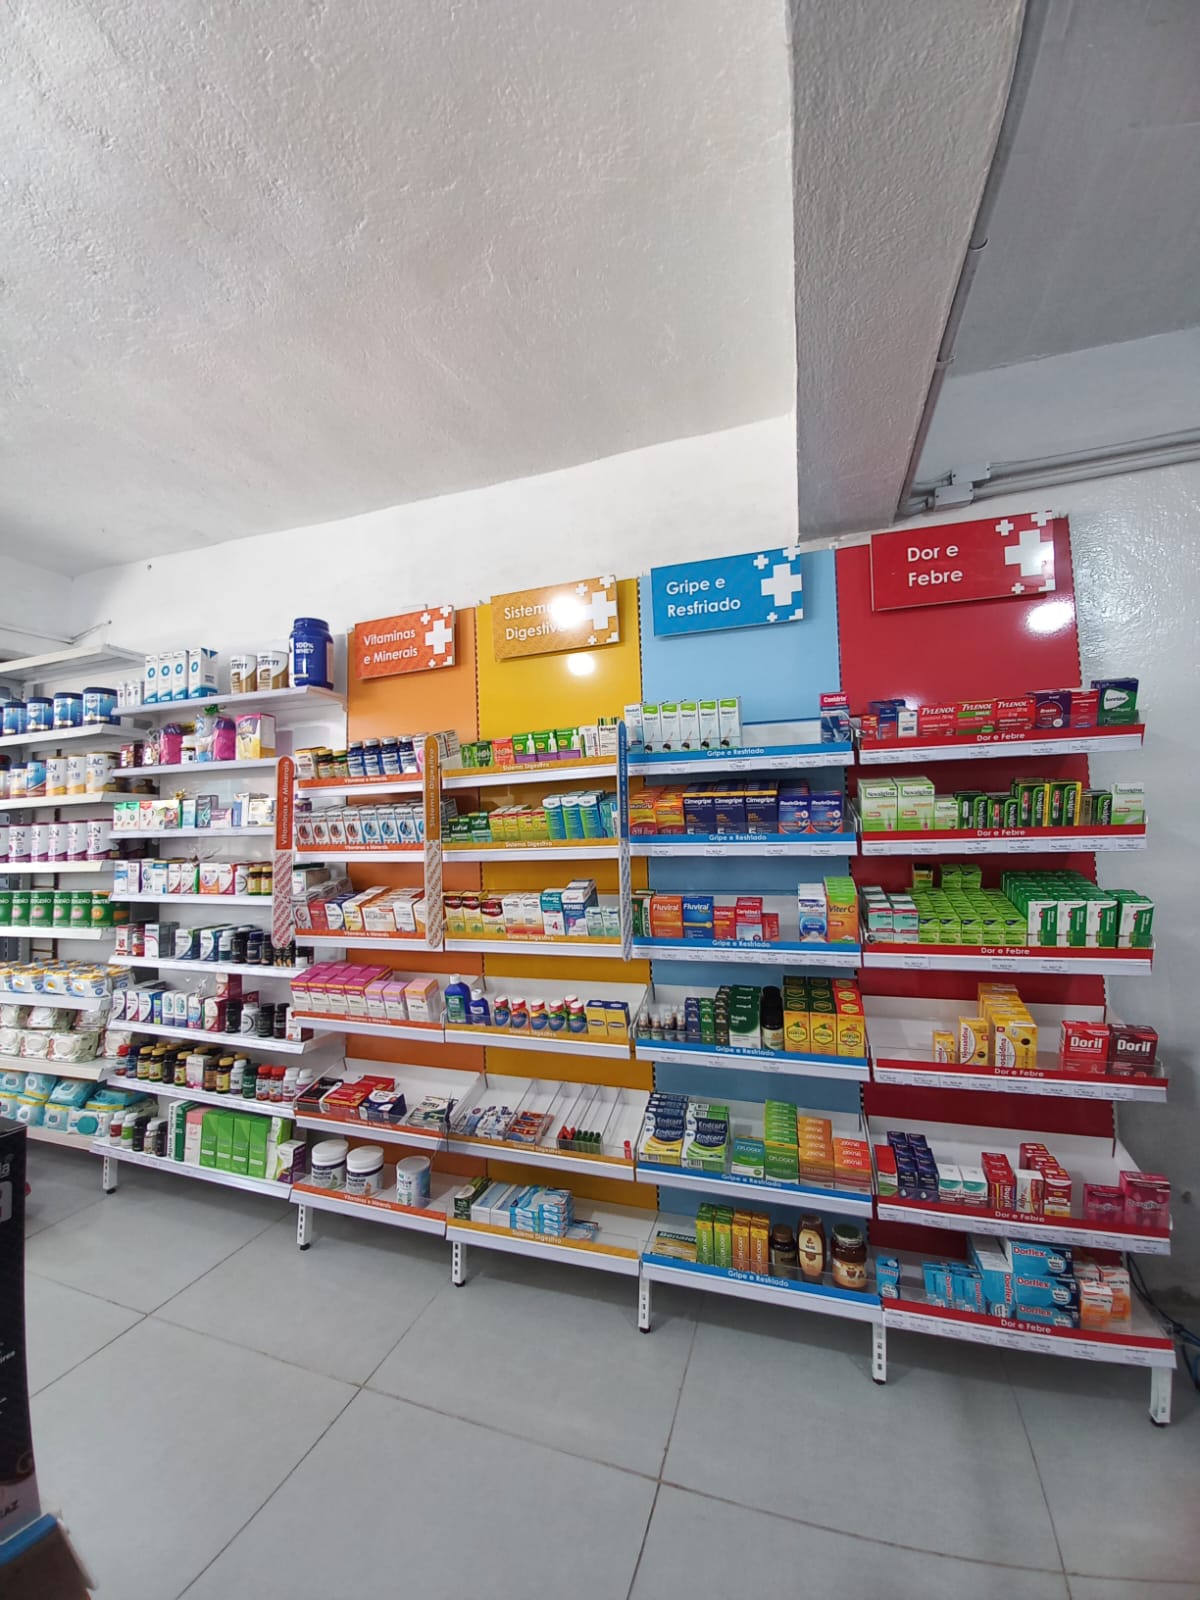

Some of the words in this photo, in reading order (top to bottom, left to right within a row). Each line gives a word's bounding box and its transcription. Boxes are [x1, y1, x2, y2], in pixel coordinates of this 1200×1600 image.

[907, 547, 940, 562] Dor
[946, 545, 959, 557] e
[908, 569, 963, 587] Febre
[666, 579, 710, 596] Gripe
[715, 578, 726, 588] e
[504, 604, 557, 620] Sistem
[667, 598, 741, 618] Resfriado
[363, 628, 416, 646] Vitaminas
[363, 656, 371, 666] e
[373, 646, 418, 663] Minerais
[962, 703, 993, 711] TYLENOL
[997, 700, 1028, 709] TYLENOL
[921, 706, 955, 716] TYLENOL
[977, 734, 991, 742] Dor
[1001, 732, 1026, 740] Febre
[706, 750, 725, 758] Gripe
[733, 747, 764, 756] Resfriado
[282, 761, 290, 795] Minerais
[709, 834, 727, 842] Gripe
[977, 829, 991, 837] Dor
[1001, 828, 1026, 836] Febre
[653, 903, 679, 911] Fluviral
[712, 939, 731, 947] Gripe
[1005, 947, 1030, 955] Febre
[1070, 1036, 1103, 1049] Doril
[1117, 1039, 1150, 1053] Doril
[1019, 1069, 1045, 1077] Febre
[995, 1210, 1010, 1219] Dor
[1019, 1214, 1045, 1223] Febre
[1013, 1246, 1045, 1258] Dorflex
[728, 1270, 747, 1280] Gripe
[1017, 1277, 1049, 1289] Dorflex
[1001, 1319, 1016, 1328] Dor
[1026, 1323, 1052, 1334] Febre
